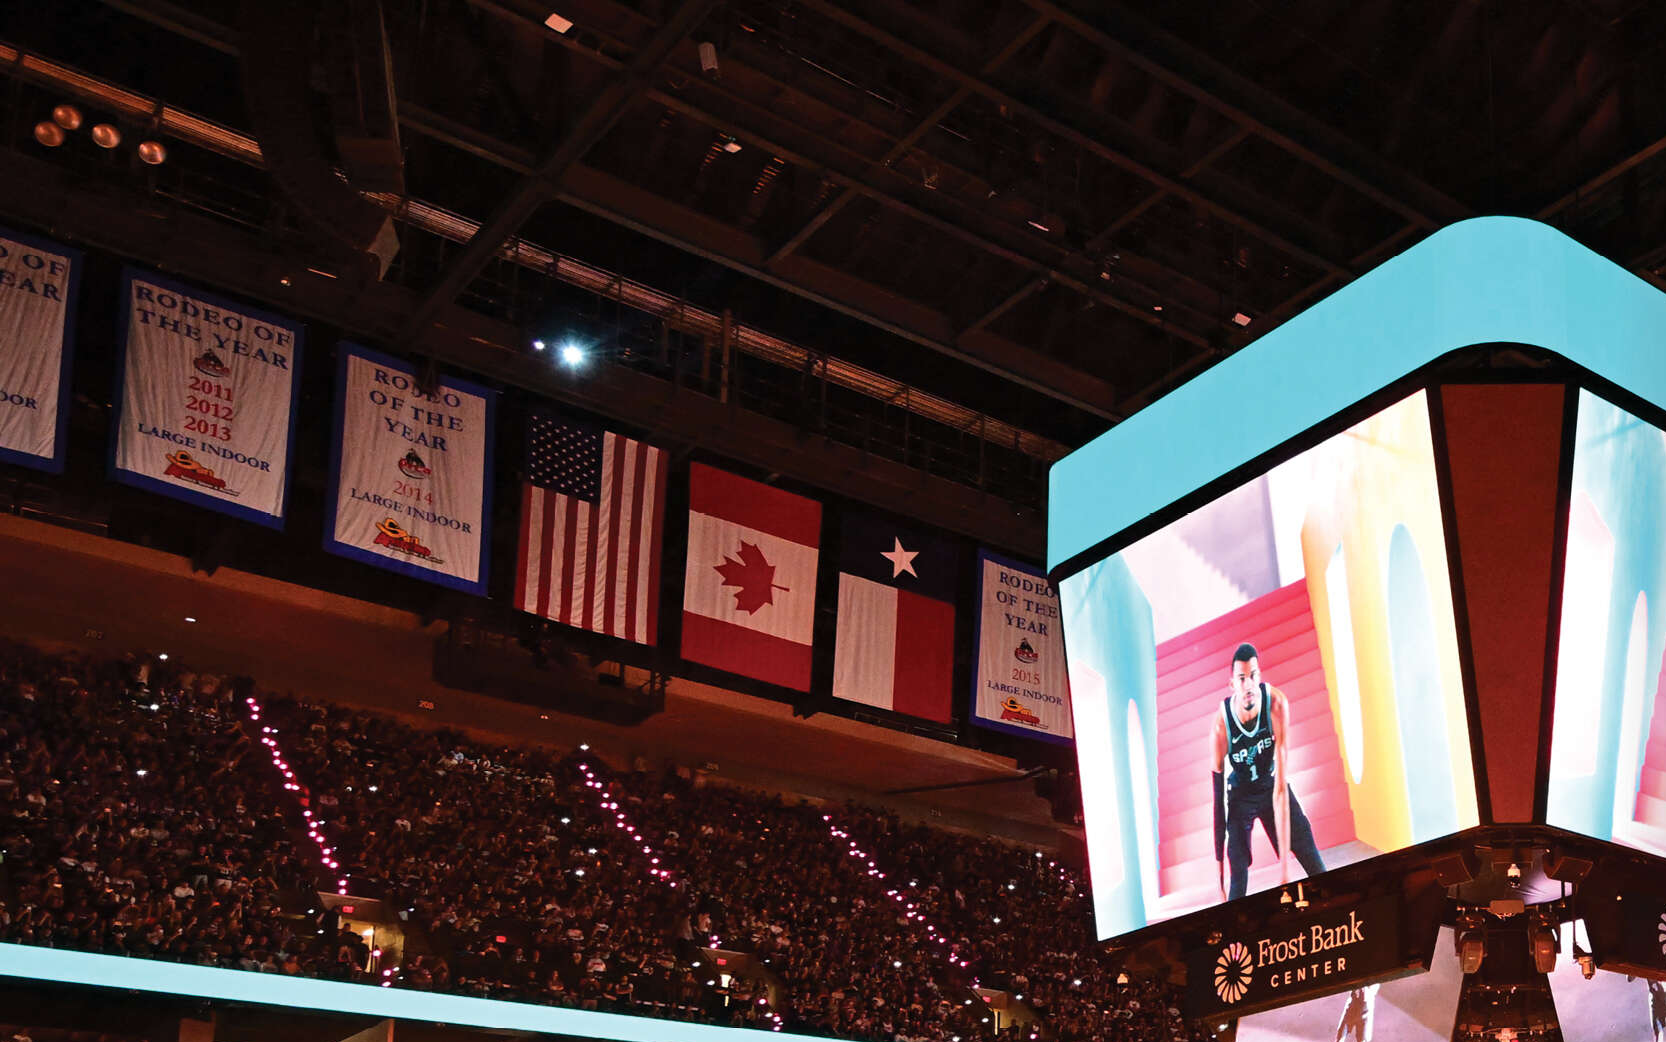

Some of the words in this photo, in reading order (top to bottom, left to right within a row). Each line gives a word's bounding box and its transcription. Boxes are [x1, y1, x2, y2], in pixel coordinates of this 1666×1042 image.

[22, 254, 65, 277] OF
[0, 268, 62, 302] EAR
[135, 285, 243, 332] RODEO
[253, 325, 291, 347] OF
[136, 308, 201, 342] THE
[213, 332, 289, 370] YEAR
[188, 375, 233, 402] 2011
[185, 395, 234, 423] 2012
[369, 390, 405, 411] OF
[411, 405, 464, 432] THE
[183, 415, 233, 442] 2013
[383, 416, 448, 451] YEAR
[138, 423, 197, 449] LARGE
[200, 441, 272, 473] INDOOR
[392, 480, 433, 506] 2014
[350, 487, 403, 513] LARGE
[407, 504, 473, 534] INDOOR
[999, 571, 1057, 598] RODEO
[996, 590, 1018, 607] OF
[1023, 598, 1058, 619] THE
[1004, 612, 1049, 637] YEAR
[1011, 667, 1041, 686] 2015
[987, 679, 1021, 696] LARGE
[1022, 688, 1063, 706] INDOOR
[1250, 765, 1259, 781] 1
[1257, 932, 1307, 967] Frost
[1310, 910, 1365, 954] Bank
[1270, 957, 1346, 988] CENTER
